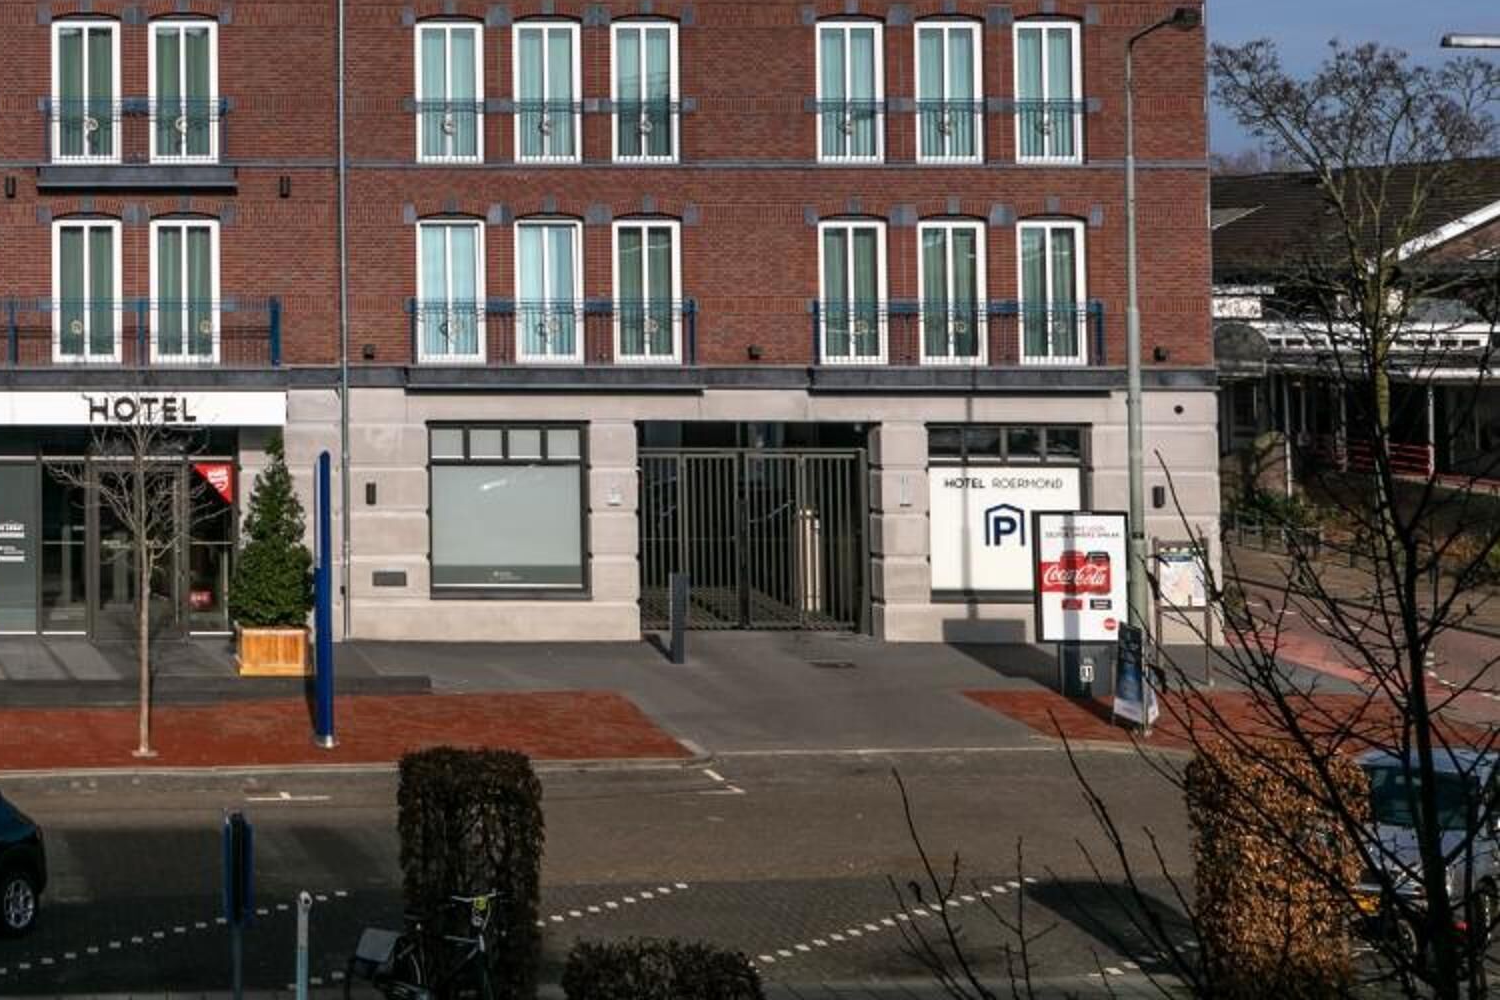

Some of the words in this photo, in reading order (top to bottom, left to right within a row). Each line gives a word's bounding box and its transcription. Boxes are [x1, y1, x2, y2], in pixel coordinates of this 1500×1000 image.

[89, 396, 197, 423] HOTEL
[944, 478, 985, 489] HOTEL
[991, 478, 1063, 489] ROERMOND
